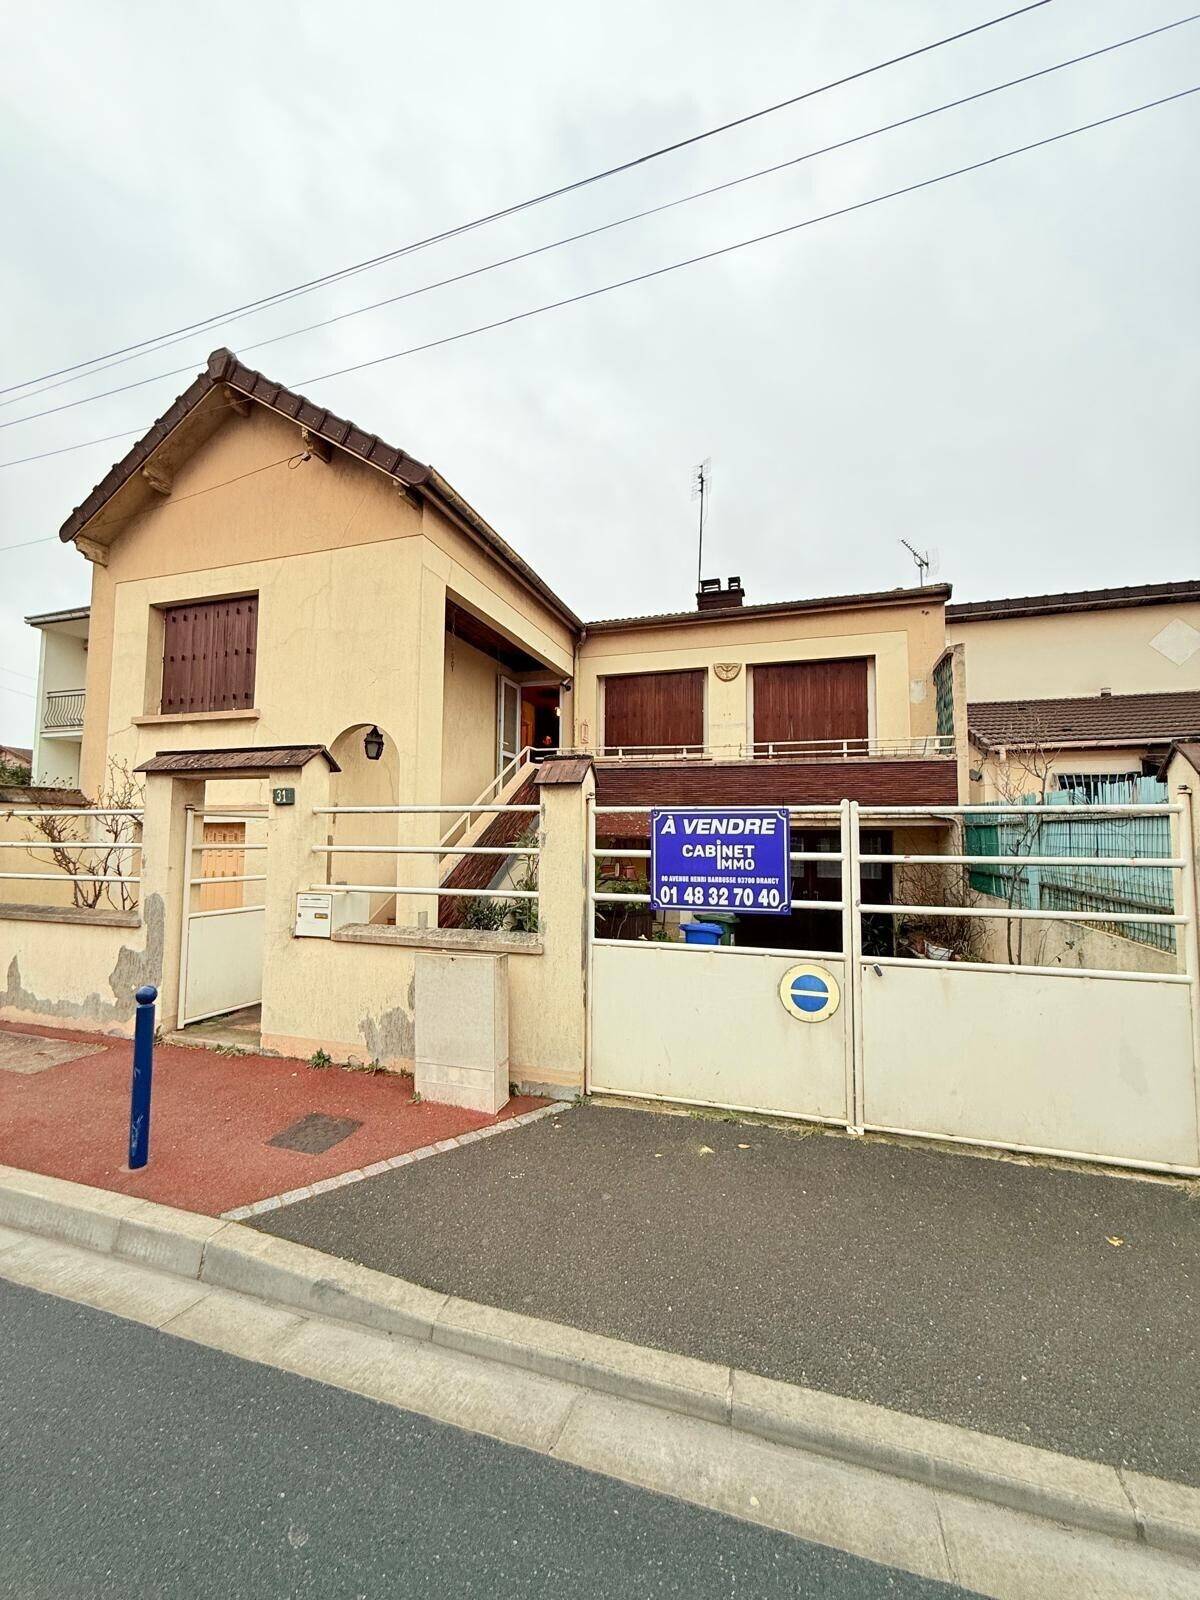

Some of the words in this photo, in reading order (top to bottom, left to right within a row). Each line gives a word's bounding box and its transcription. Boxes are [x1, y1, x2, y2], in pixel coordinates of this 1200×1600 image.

[276, 789, 286, 802] 31
[661, 816, 676, 835] À
[683, 818, 776, 835] VENDRE
[756, 877, 779, 885] DRANCY
[660, 886, 677, 904] 01
[684, 887, 704, 905] 48
[708, 888, 729, 905] 32
[733, 888, 754, 906] 70
[758, 889, 780, 907] 40
